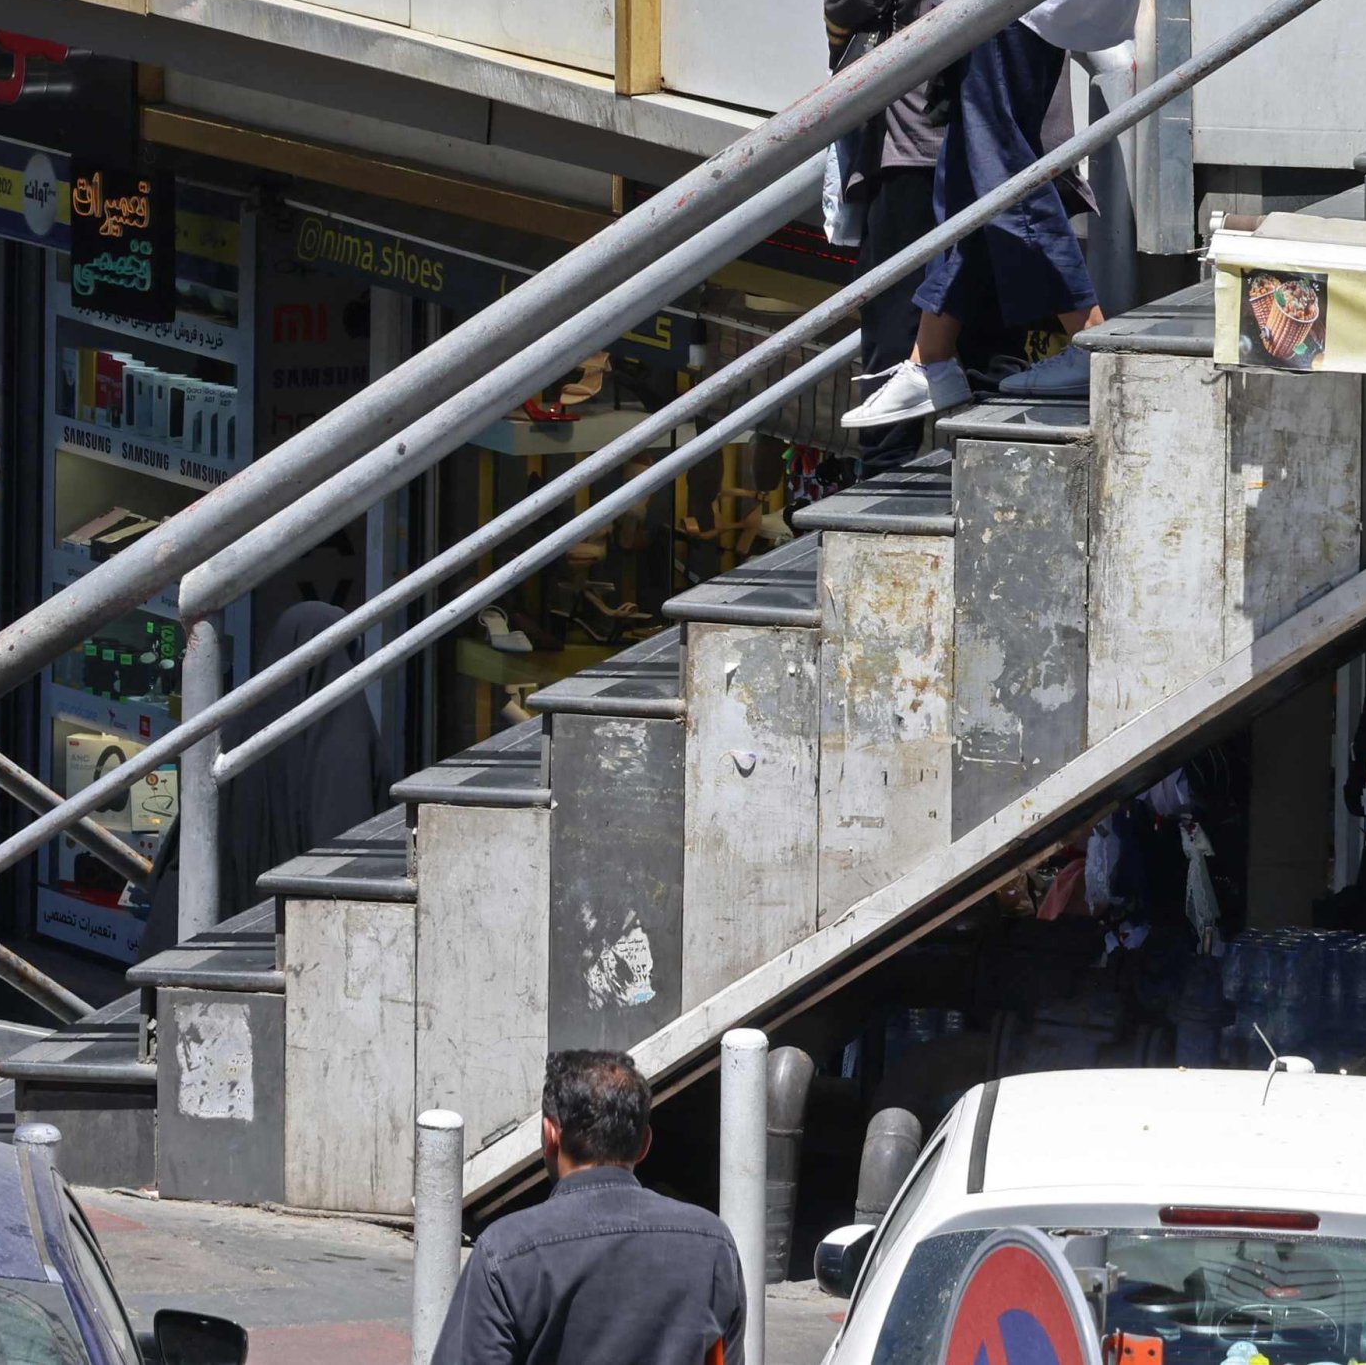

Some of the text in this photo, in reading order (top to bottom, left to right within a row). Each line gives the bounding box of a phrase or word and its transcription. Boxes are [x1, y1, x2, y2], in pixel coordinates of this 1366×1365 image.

[73, 172, 150, 237] تعمیرات
[73, 238, 152, 296] تخصصی
[297, 216, 445, 294] @nima.shoes
[174, 322, 198, 342] فروش
[199, 332, 204, 347] و
[205, 331, 224, 351] خرید
[272, 363, 370, 390] SAMSUN
[63, 425, 228, 485] SAMSUNG SAMSUNG SAMSUNG
[43, 909, 113, 939] تعمیرات تخصصی
